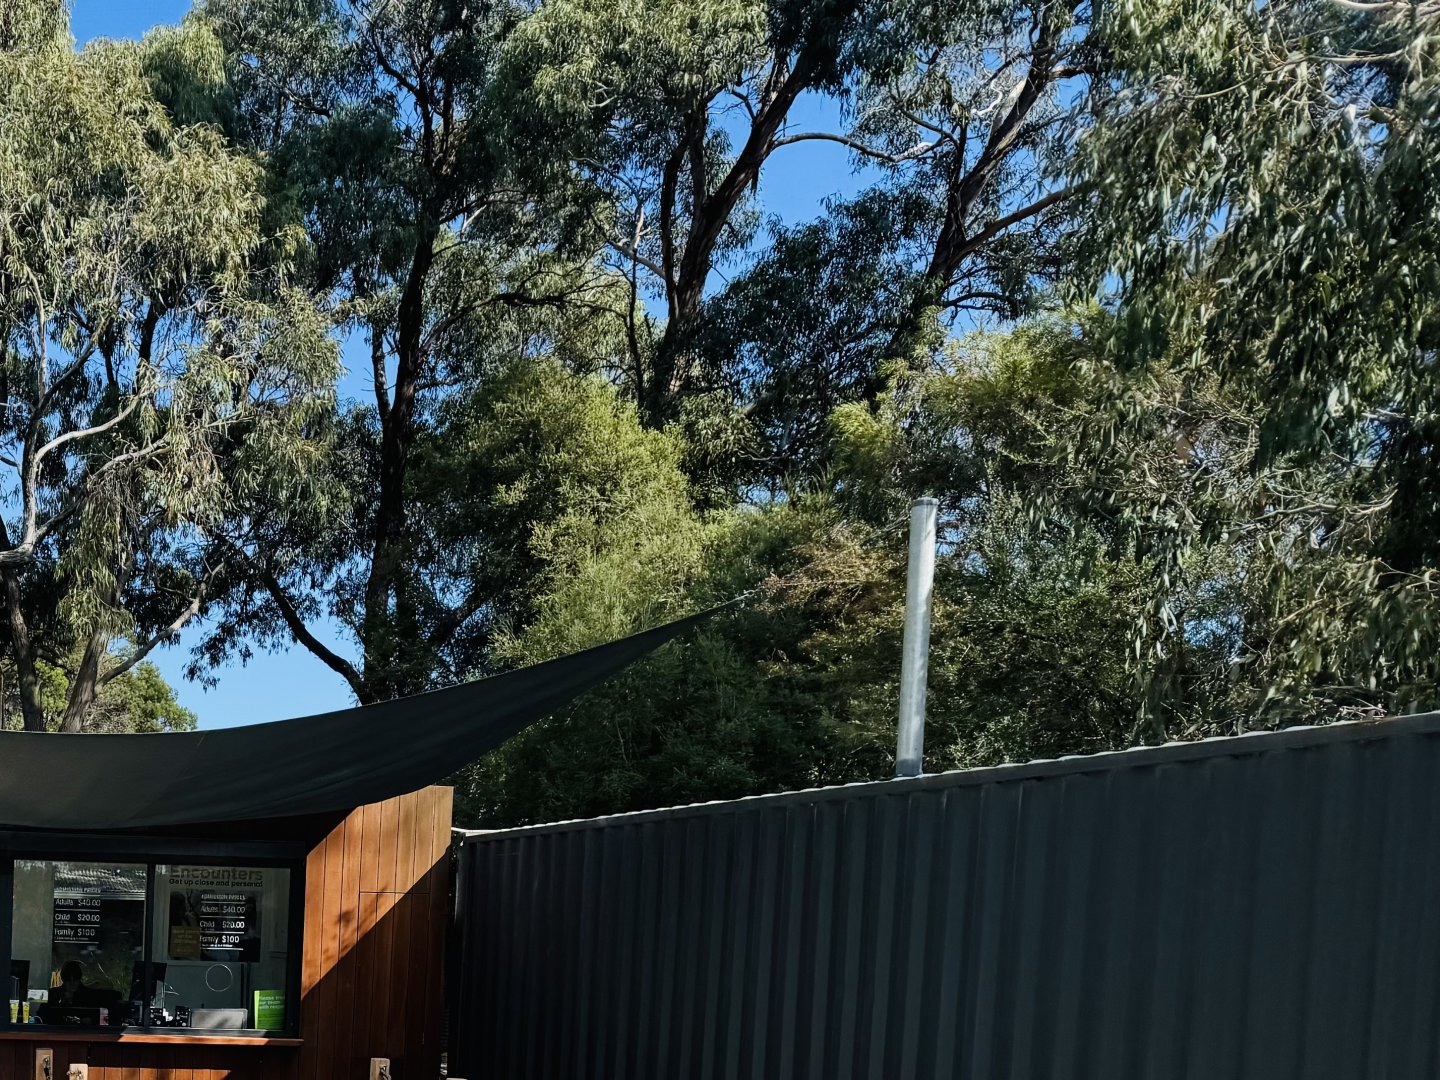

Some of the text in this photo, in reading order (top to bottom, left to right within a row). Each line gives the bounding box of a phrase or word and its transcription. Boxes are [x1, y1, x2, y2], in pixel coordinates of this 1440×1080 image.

[170, 865, 263, 881] Encounters
[231, 880, 263, 888] personal
[55, 898, 101, 907] Adults $40.00
[222, 905, 246, 913] $40.00
[55, 913, 101, 922] Child $20.00
[222, 921, 245, 929] $20.00
[54, 928, 95, 937] Family $100
[199, 935, 240, 944] Family $100
